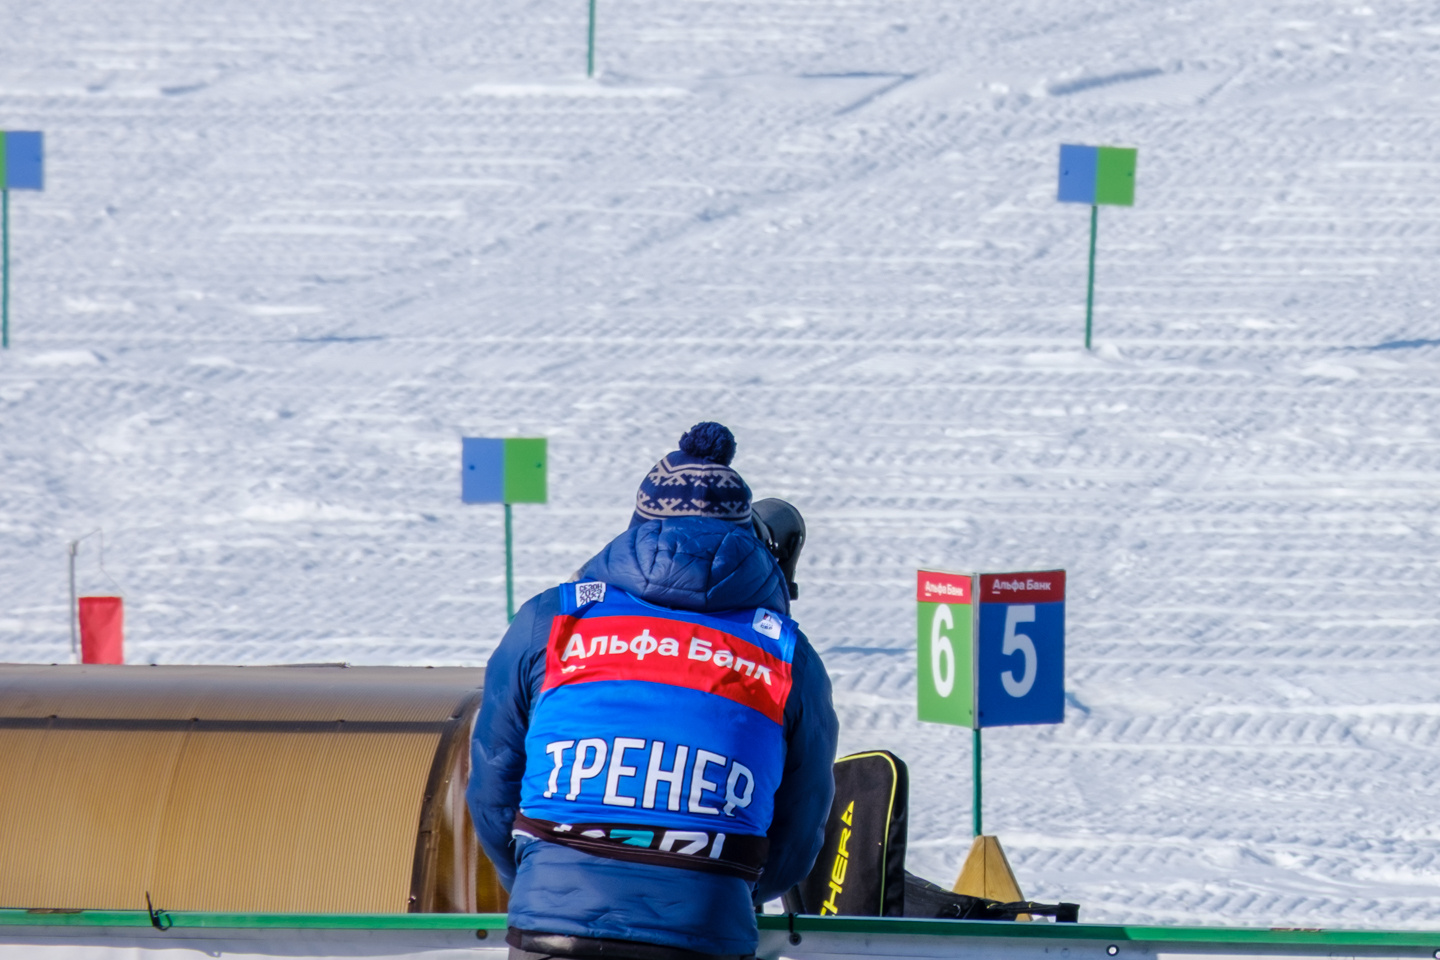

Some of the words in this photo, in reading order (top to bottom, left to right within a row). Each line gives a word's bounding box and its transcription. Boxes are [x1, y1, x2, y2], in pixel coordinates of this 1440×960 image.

[924, 581, 947, 596] Альфа
[947, 584, 963, 597] Банк
[992, 579, 1025, 592] Альфа
[1026, 579, 1051, 590] Банк
[561, 629, 679, 662] Альфа
[931, 603, 955, 698] 6
[1001, 605, 1037, 698] 5
[543, 737, 755, 817] ТРЕНЕР
